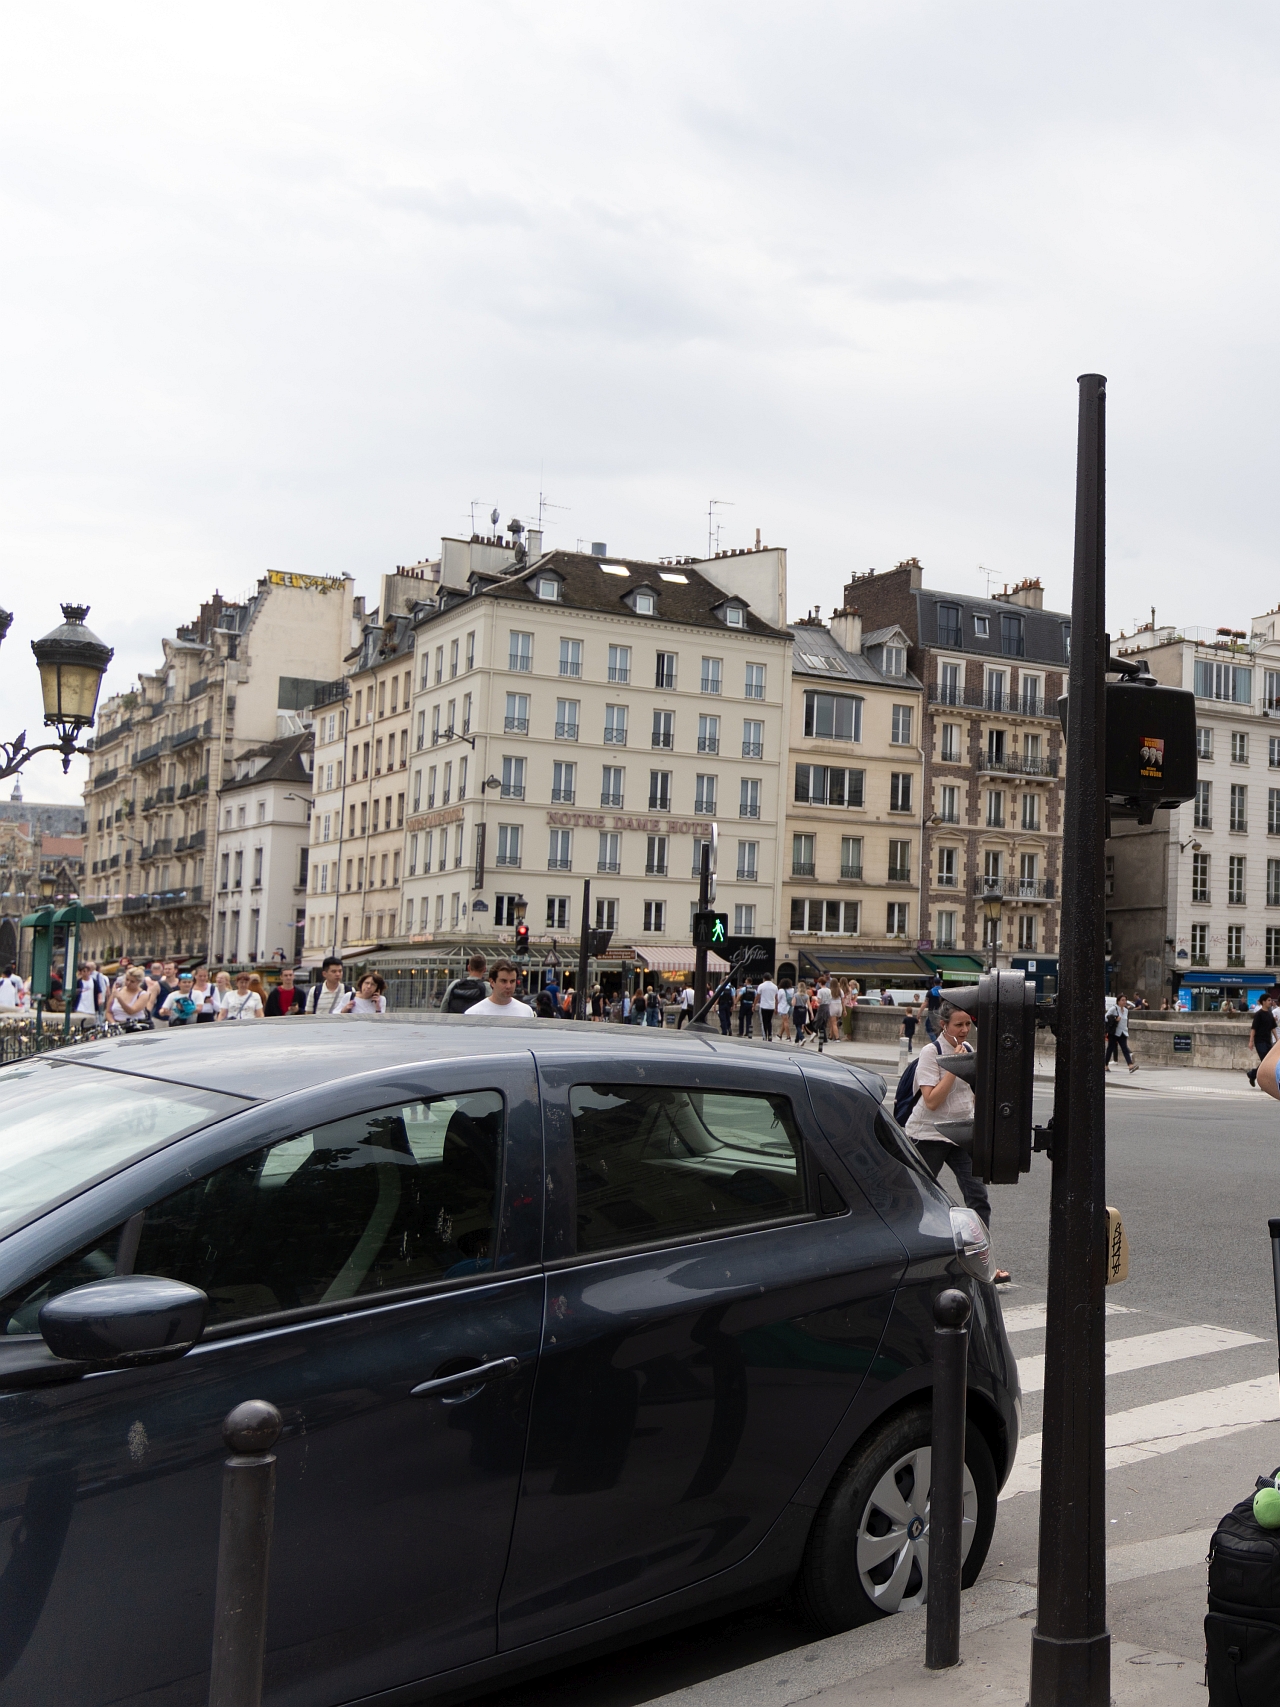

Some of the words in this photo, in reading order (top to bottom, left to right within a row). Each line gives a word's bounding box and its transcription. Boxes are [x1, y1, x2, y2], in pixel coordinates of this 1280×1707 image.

[546, 811, 605, 828] NOTRE
[613, 816, 661, 832] DAME
[667, 820, 720, 836] HOTE
